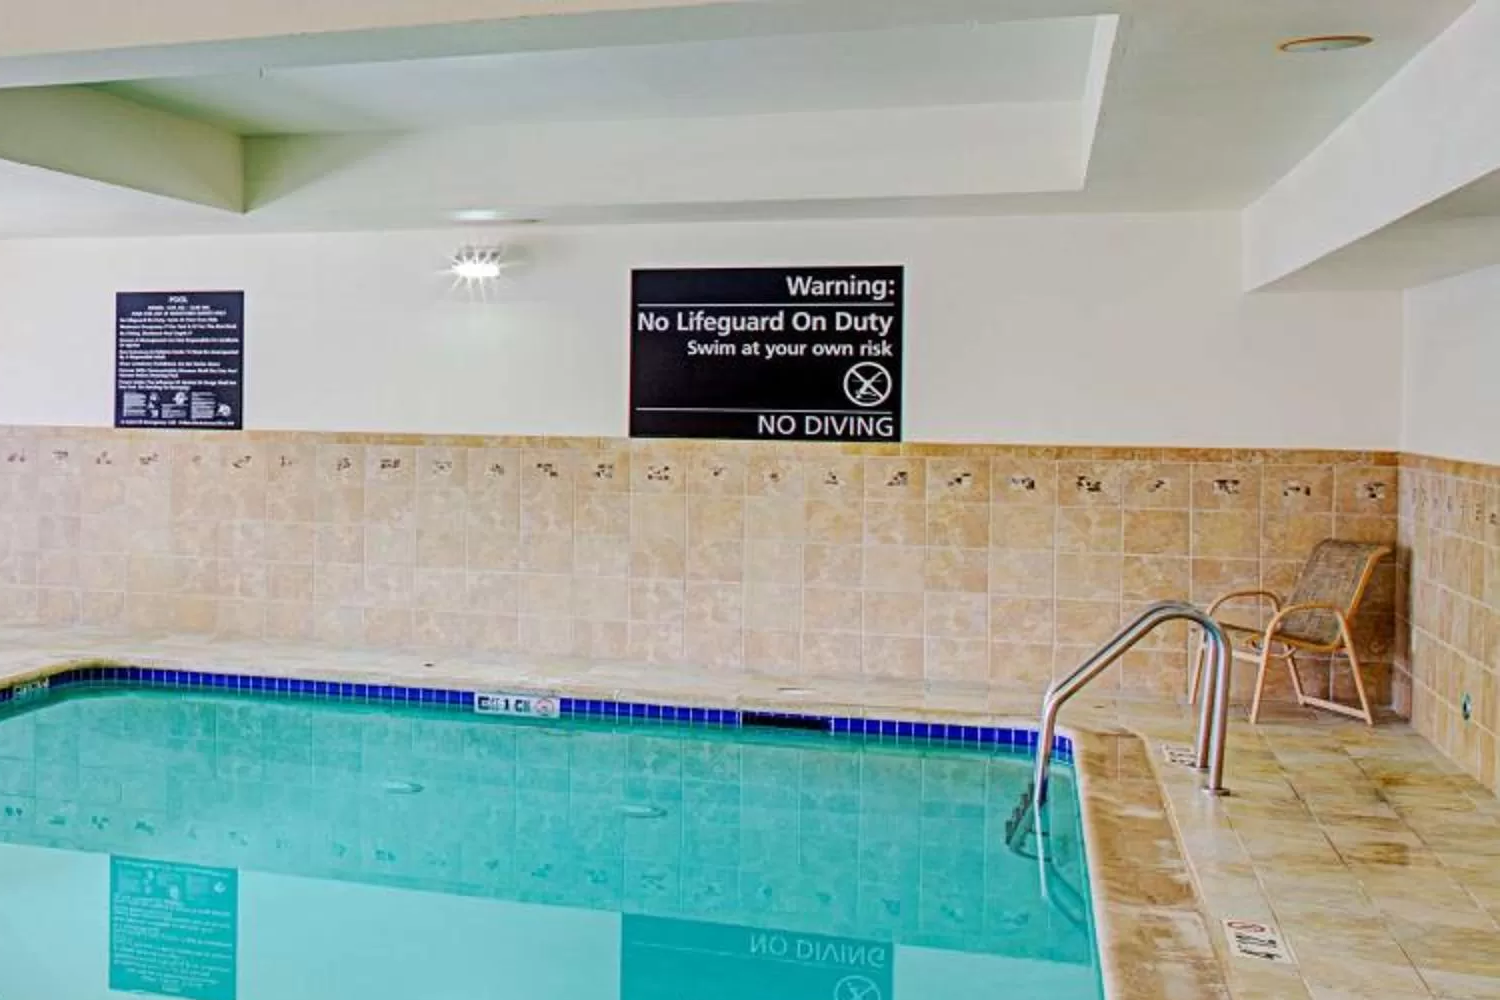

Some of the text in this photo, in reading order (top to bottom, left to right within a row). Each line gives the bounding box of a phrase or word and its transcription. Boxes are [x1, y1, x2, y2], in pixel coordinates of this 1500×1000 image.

[786, 274, 895, 301] Warning:
[637, 310, 894, 337] No Lifeguard On Duty
[687, 339, 894, 360] Swim at your own risk
[758, 415, 893, 437] NO DIVING
